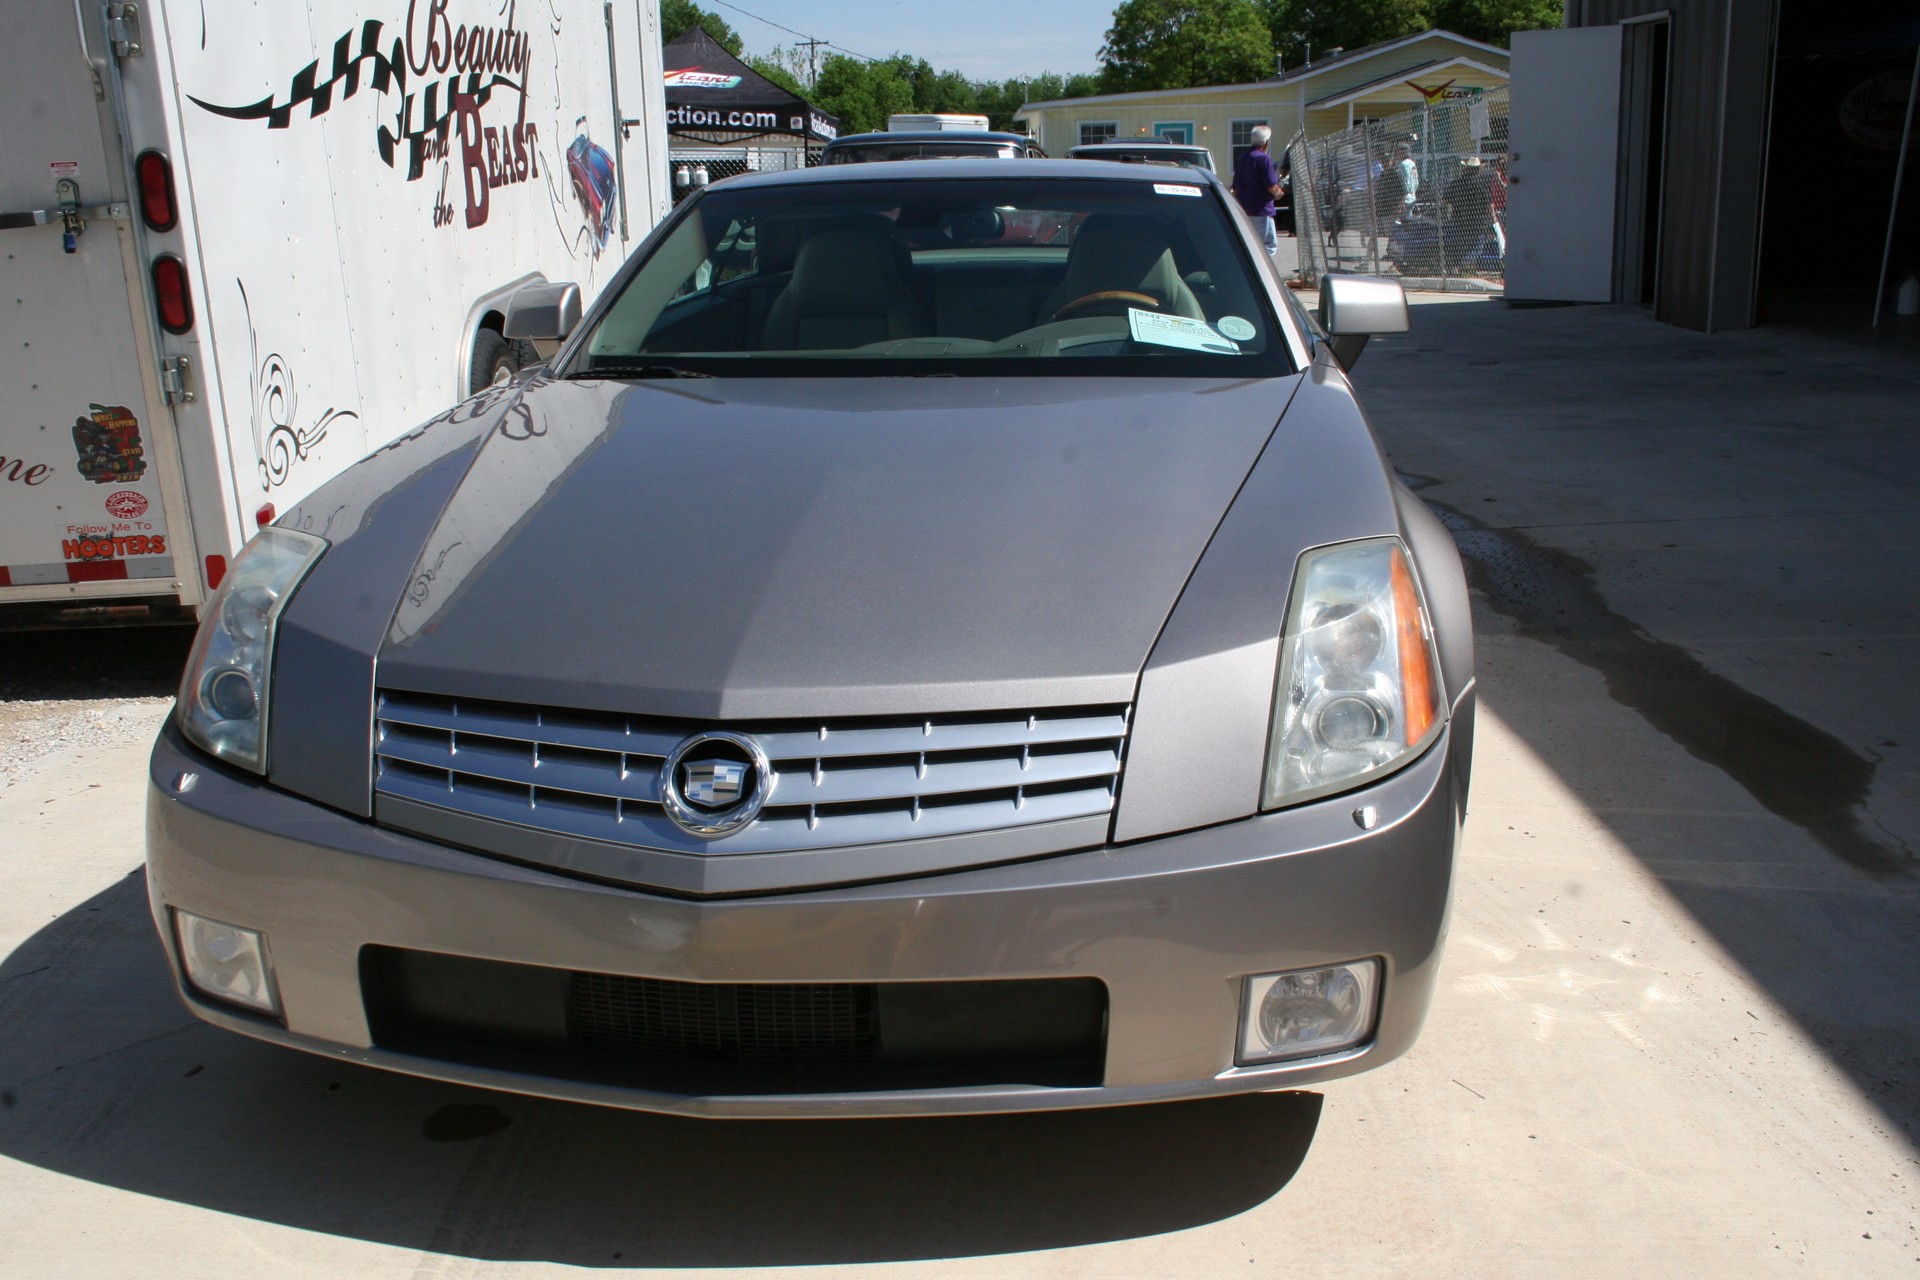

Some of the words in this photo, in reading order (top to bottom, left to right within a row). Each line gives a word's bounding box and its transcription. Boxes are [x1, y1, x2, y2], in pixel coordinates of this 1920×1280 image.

[405, 0, 532, 133] Beauty
[455, 93, 539, 229] BEAST
[433, 160, 454, 229] the
[92, 413, 113, 423] WHAT
[108, 419, 138, 430] HAPPENS
[116, 510, 140, 519] TEXAS
[67, 525, 107, 534] Follow
[112, 523, 131, 532] Me
[134, 521, 152, 531] To
[62, 535, 166, 560] HOOTERS
